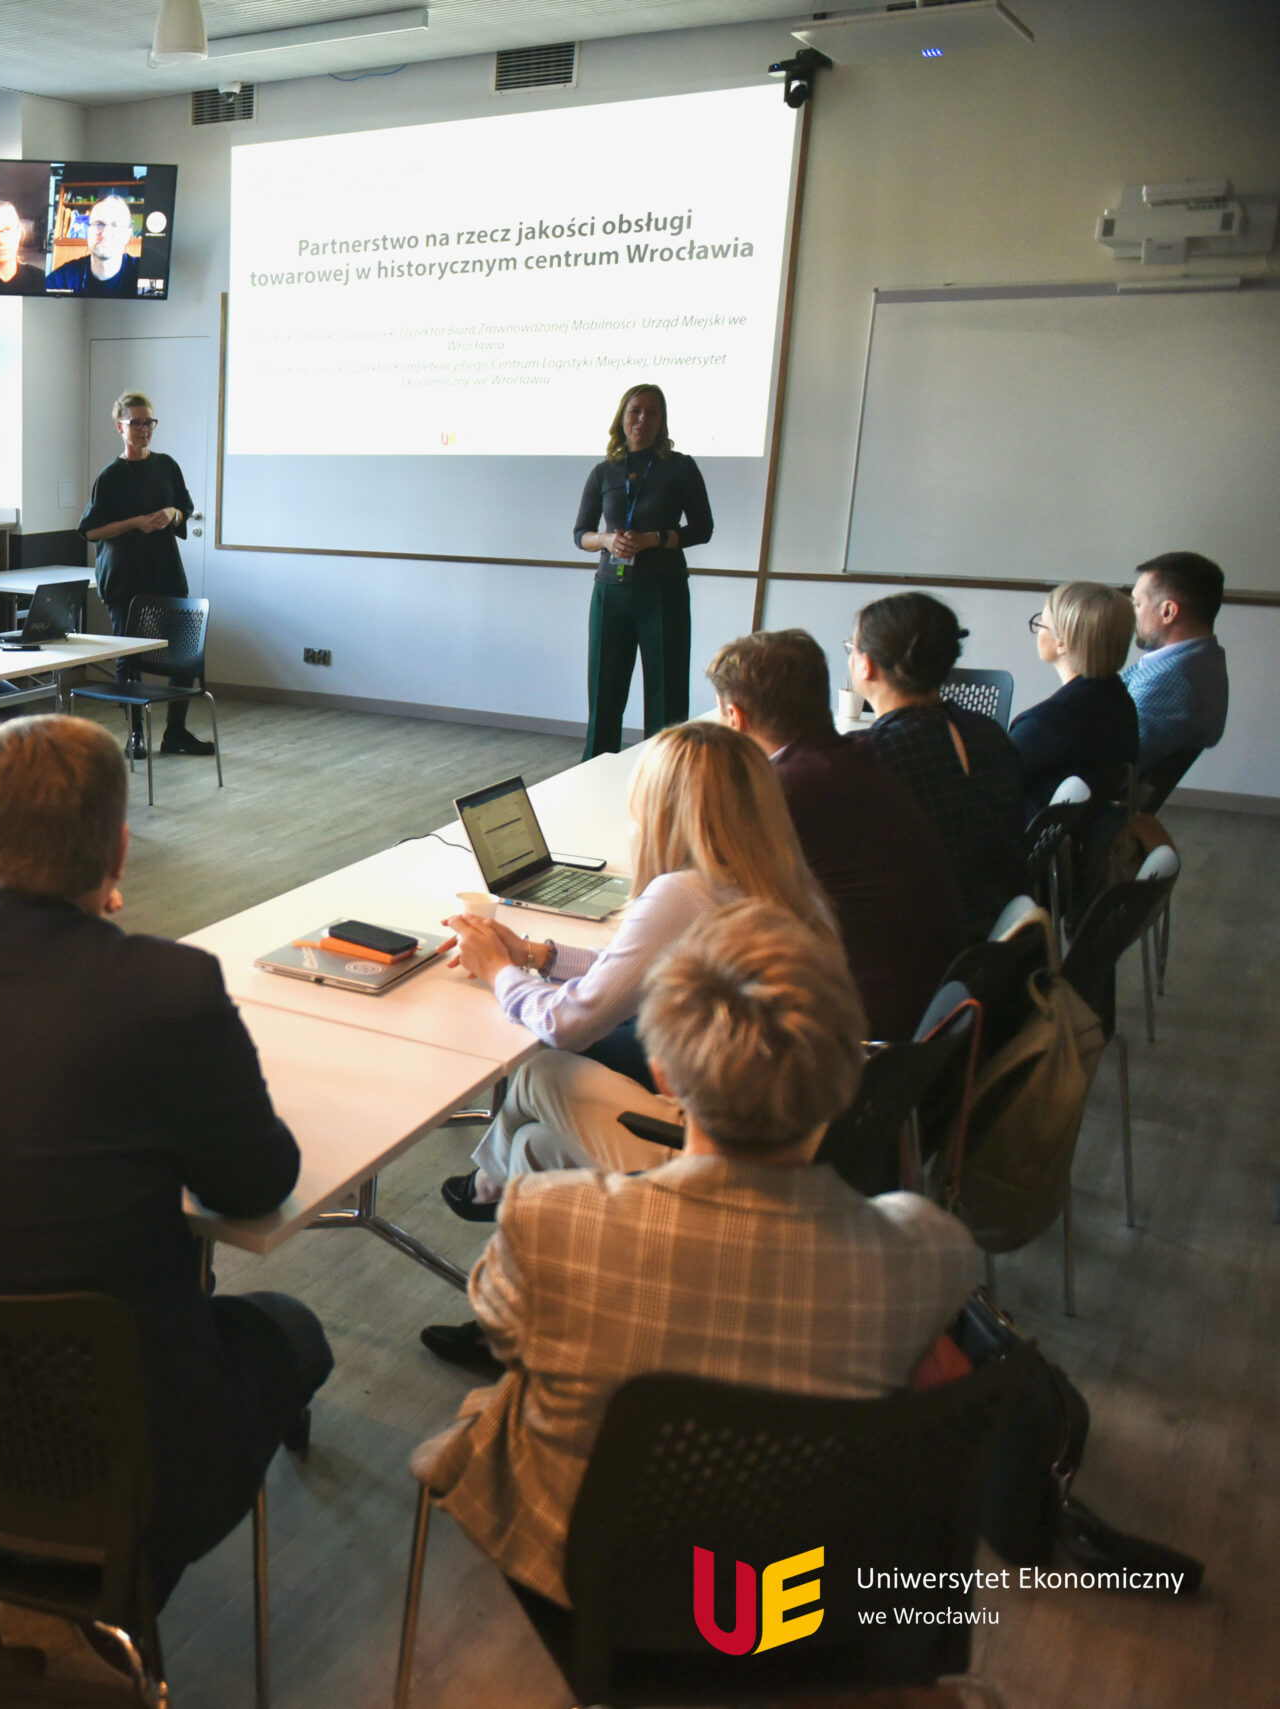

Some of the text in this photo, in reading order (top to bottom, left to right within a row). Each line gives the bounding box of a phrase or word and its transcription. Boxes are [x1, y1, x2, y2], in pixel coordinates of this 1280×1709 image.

[298, 208, 693, 257] Partnerstwo na rzecz jakości obsługi
[250, 237, 754, 287] towarowej w historycznym centrum Wrocławia
[641, 315, 680, 331] Urząd
[681, 313, 725, 329] Miejski
[727, 316, 747, 327] we
[490, 357, 540, 371] Centrum
[542, 356, 593, 372] Logistyki
[652, 353, 727, 368] Uniwersytet
